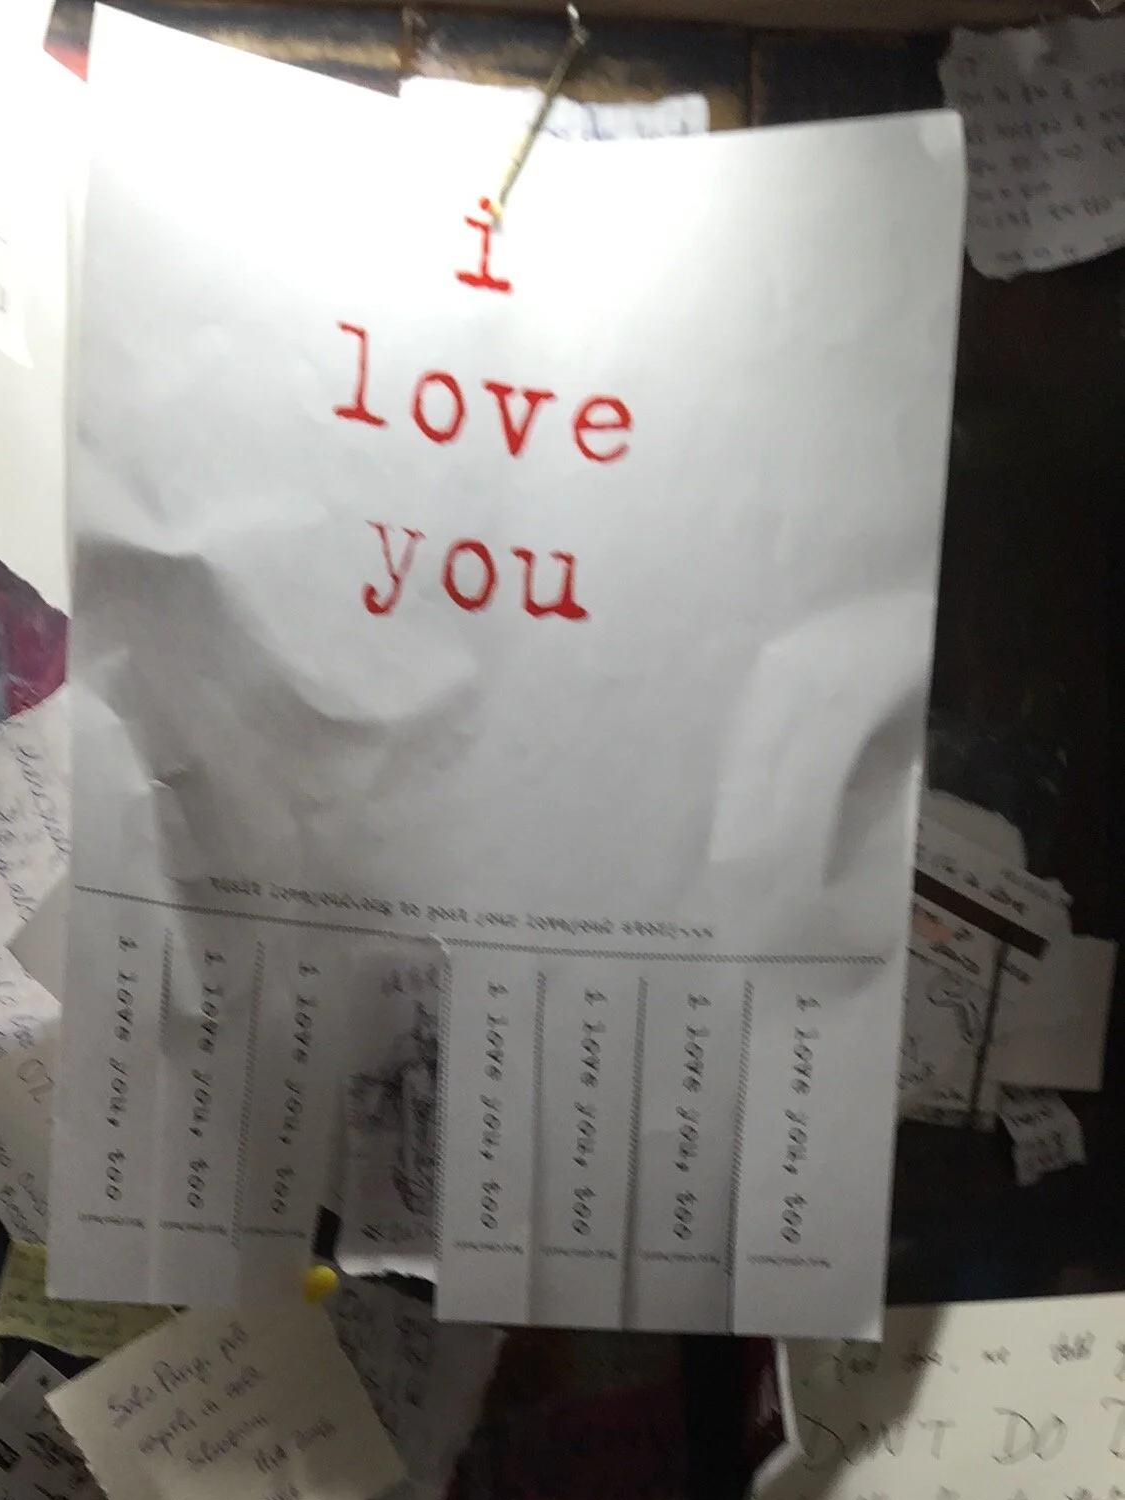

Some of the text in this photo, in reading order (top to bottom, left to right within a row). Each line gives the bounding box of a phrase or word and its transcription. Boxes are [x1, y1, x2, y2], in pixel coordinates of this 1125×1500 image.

[455, 196, 513, 294] i
[332, 322, 635, 464] love
[361, 518, 592, 621] you
[113, 968, 140, 1043] love
[197, 981, 227, 1055] love
[291, 993, 320, 1066] love
[483, 1011, 511, 1082] love
[578, 1018, 608, 1090] love
[681, 1021, 713, 1095] love
[789, 1024, 823, 1097] love
[105, 1148, 127, 1202] too
[186, 1156, 211, 1211] too
[271, 1165, 297, 1217] too
[478, 1177, 504, 1231] too
[571, 1184, 598, 1238] too
[672, 1189, 700, 1242] too
[779, 1191, 808, 1245] too
[991, 1406, 1070, 1467] DO
